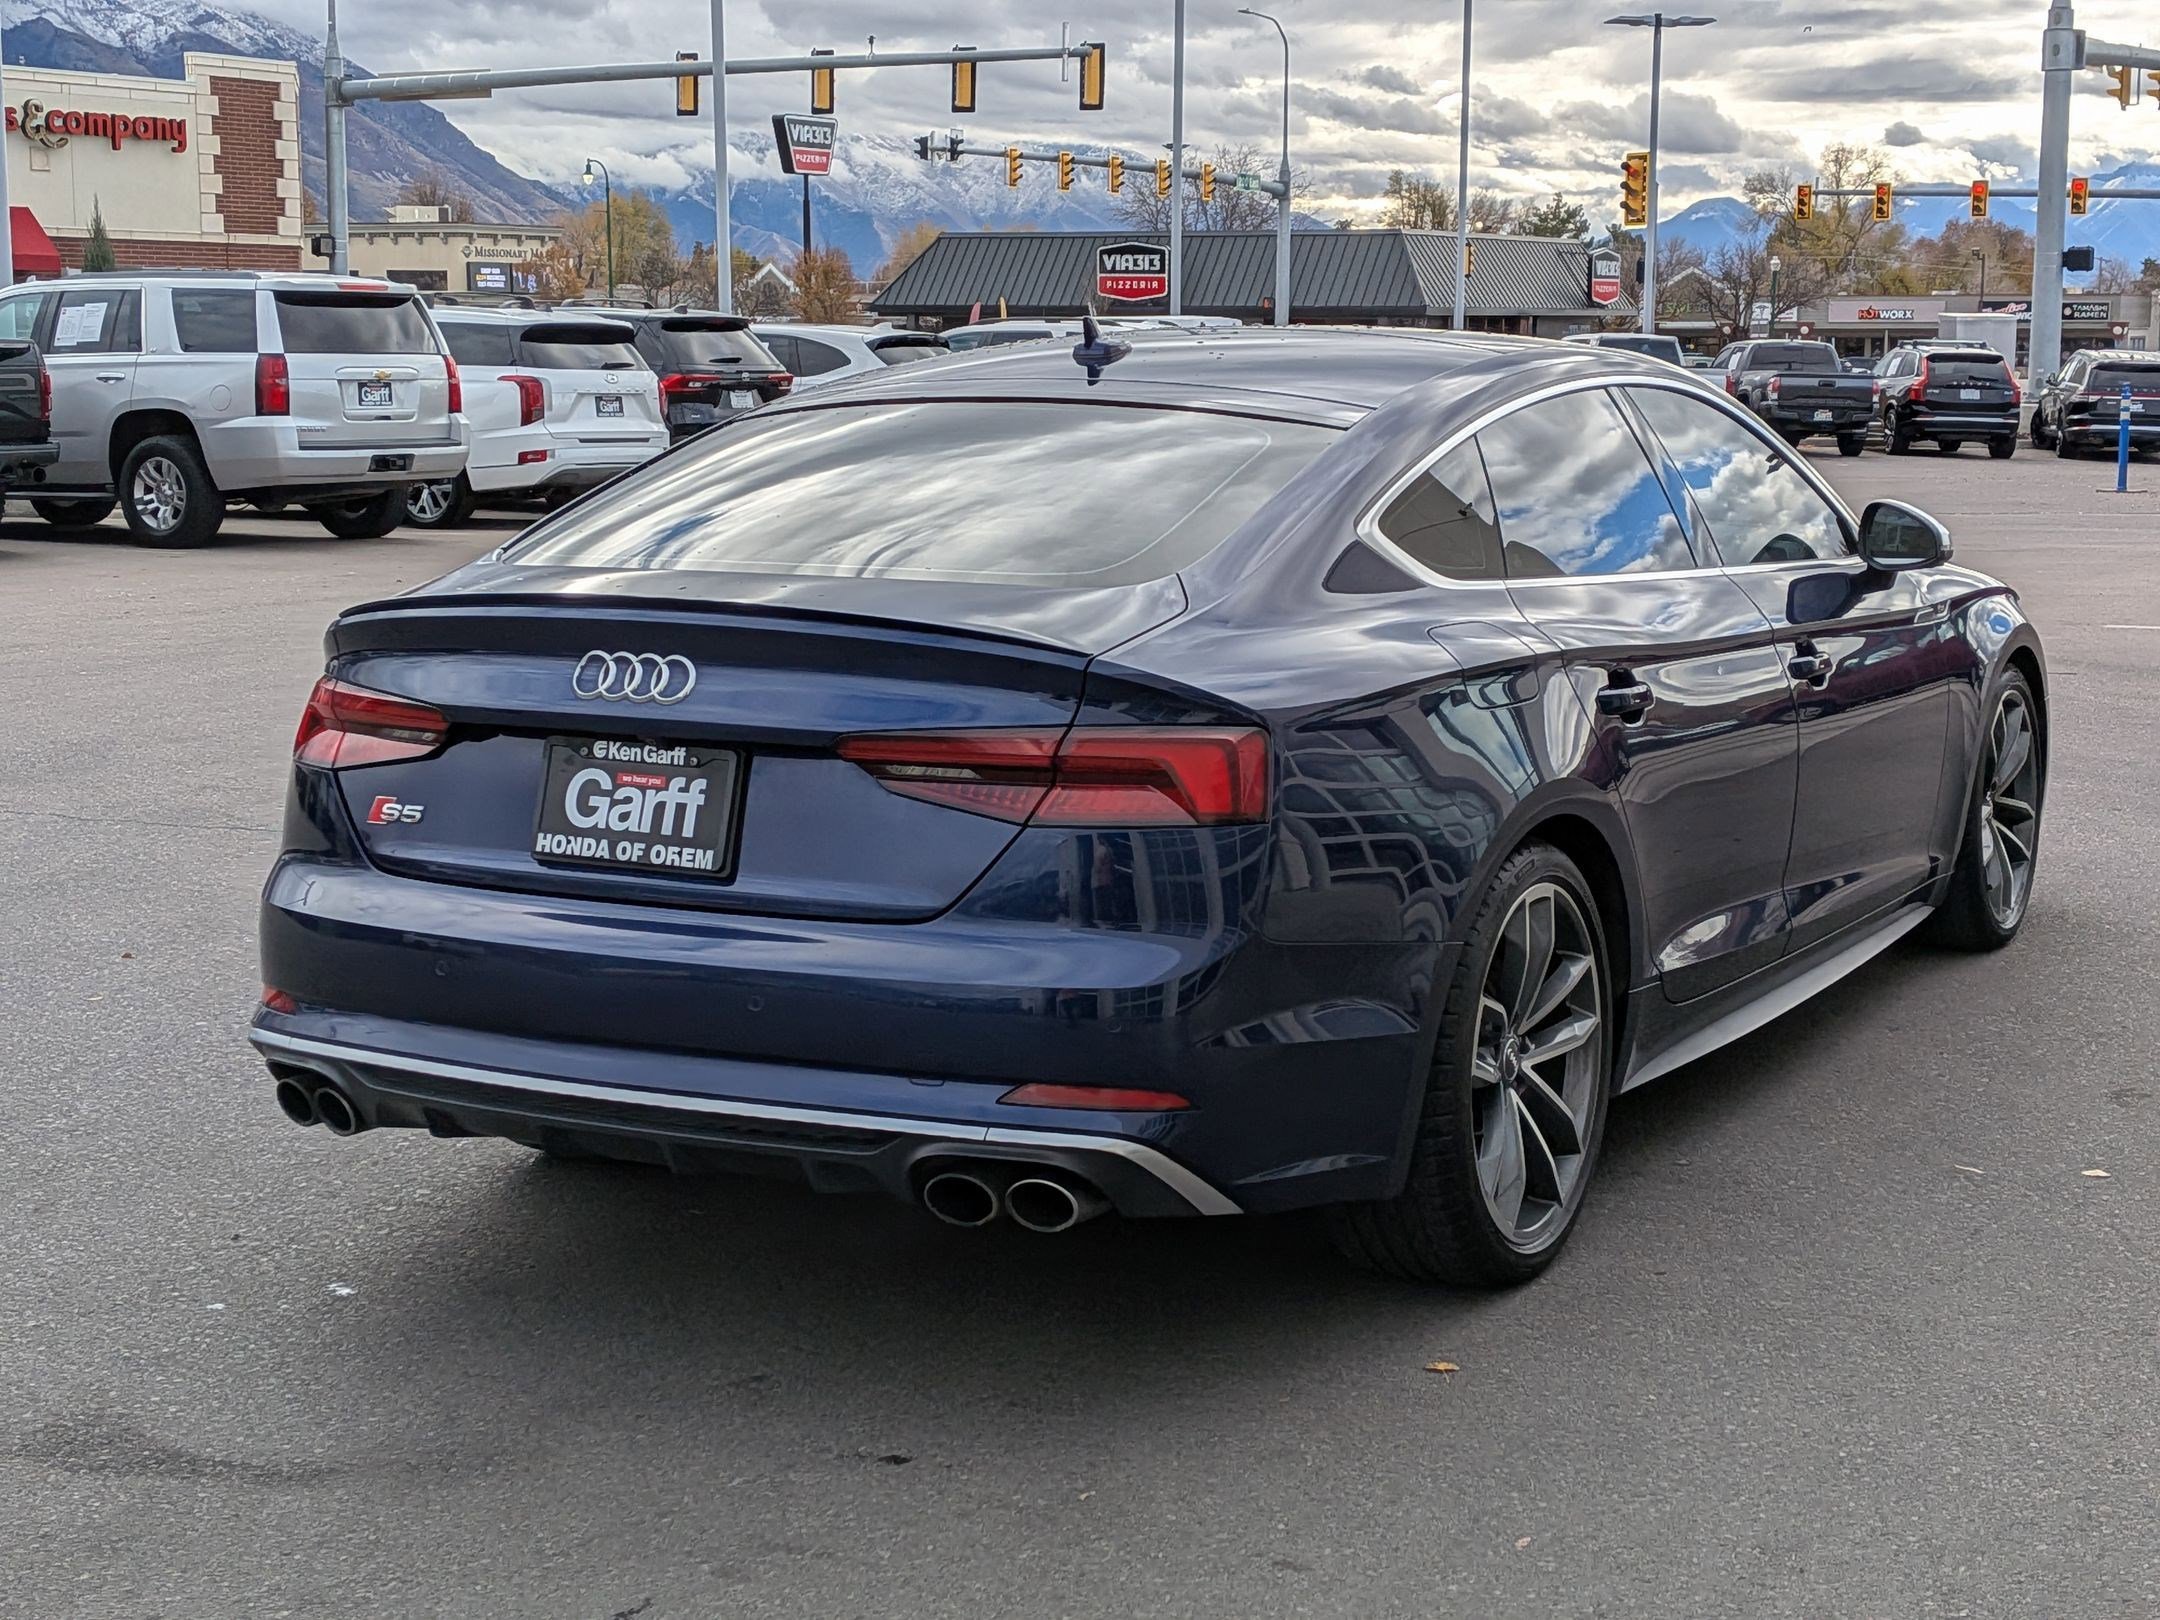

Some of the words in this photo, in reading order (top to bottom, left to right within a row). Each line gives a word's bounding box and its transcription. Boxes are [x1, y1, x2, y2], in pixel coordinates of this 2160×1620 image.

[45, 109, 187, 153] company
[1106, 280, 1159, 289] PIZZERIA
[1857, 307, 1914, 320] HOTWORX
[2073, 311, 2107, 319] RAMEN
[608, 741, 641, 762] Ken
[643, 744, 686, 766] Garff
[380, 803, 425, 823] S5
[565, 768, 708, 838] Garff
[535, 832, 610, 859] HONDA
[616, 840, 646, 862] OF
[650, 844, 714, 870] OREM
